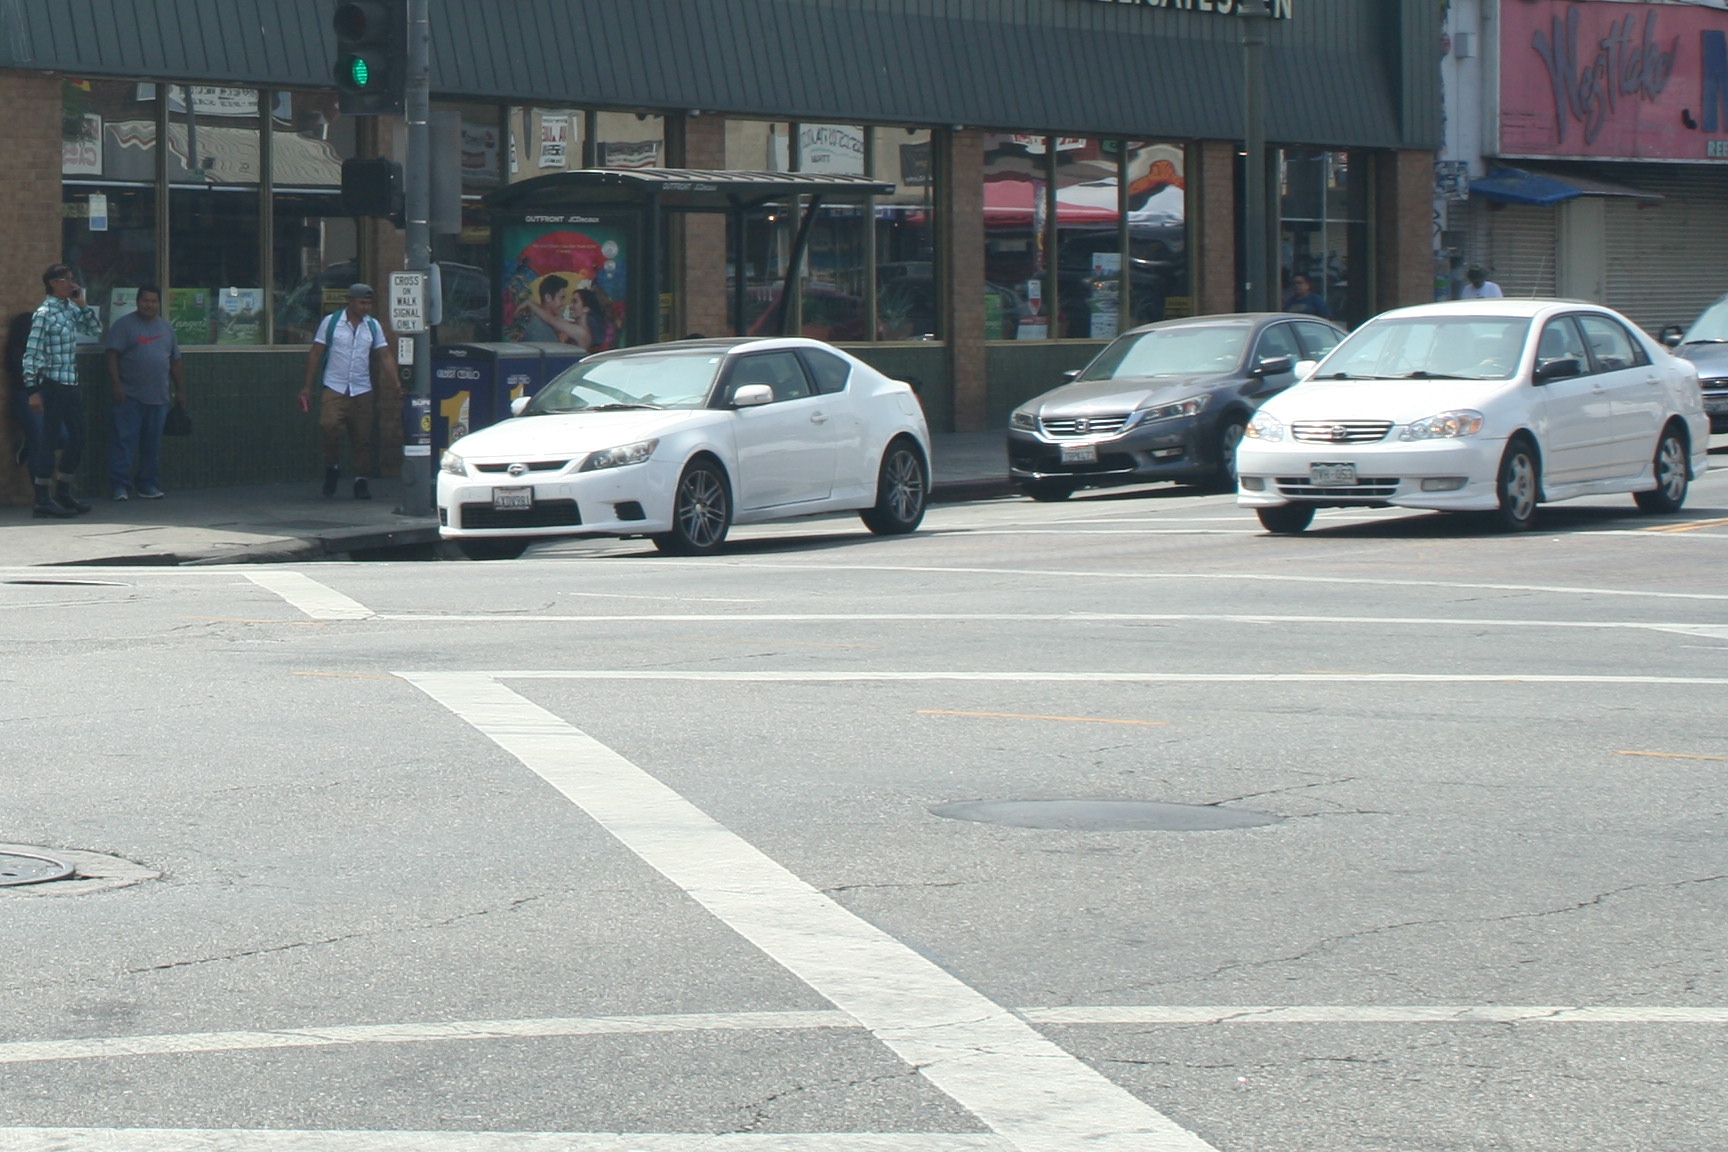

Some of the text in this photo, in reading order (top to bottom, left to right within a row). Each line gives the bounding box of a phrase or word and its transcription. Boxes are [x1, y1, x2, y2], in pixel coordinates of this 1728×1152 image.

[525, 215, 564, 223] OUTFRONT
[394, 276, 419, 286] CROSS
[397, 297, 417, 306] WALK
[393, 309, 420, 318] SIGNAL
